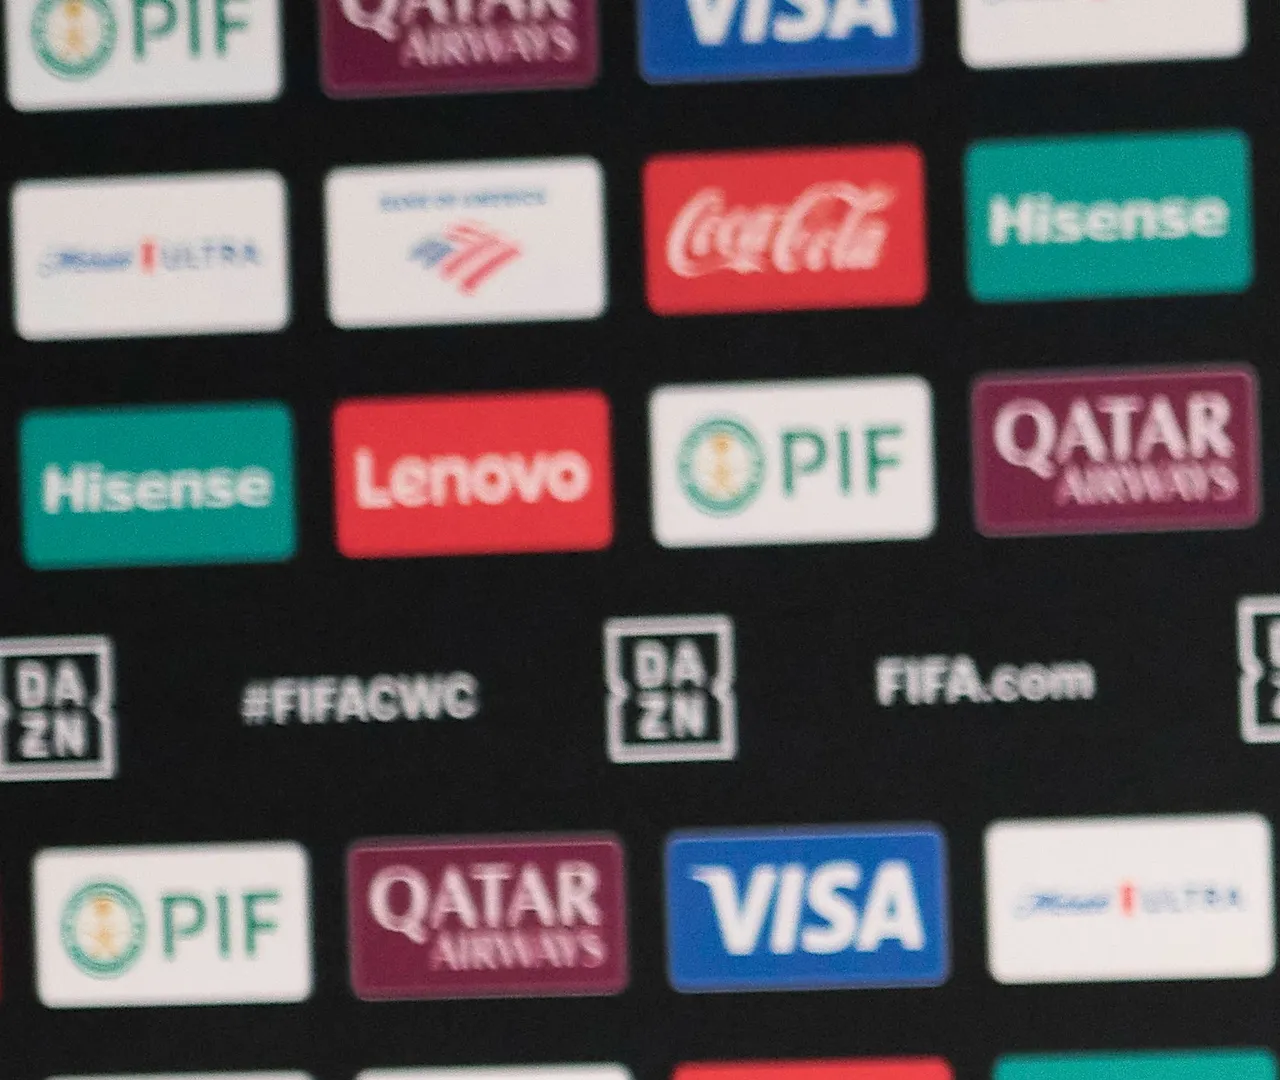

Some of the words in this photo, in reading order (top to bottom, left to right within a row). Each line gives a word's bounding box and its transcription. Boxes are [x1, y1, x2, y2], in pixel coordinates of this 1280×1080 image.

[131, 0, 247, 59] PIF
[988, 193, 1229, 245] Hisense
[780, 425, 903, 496] PIF
[994, 394, 1237, 480] QATAR
[42, 464, 273, 514] Hisense
[355, 449, 591, 508] Lenovo
[16, 660, 85, 708] DA
[634, 640, 706, 687] DA
[876, 656, 1095, 705] FIFA.com
[242, 672, 477, 724] #FIFACWC
[640, 692, 705, 738] ZN
[18, 709, 87, 760] ZN
[160, 889, 280, 958] PIF
[369, 862, 602, 943] QATAR
[693, 860, 925, 955] VISA
